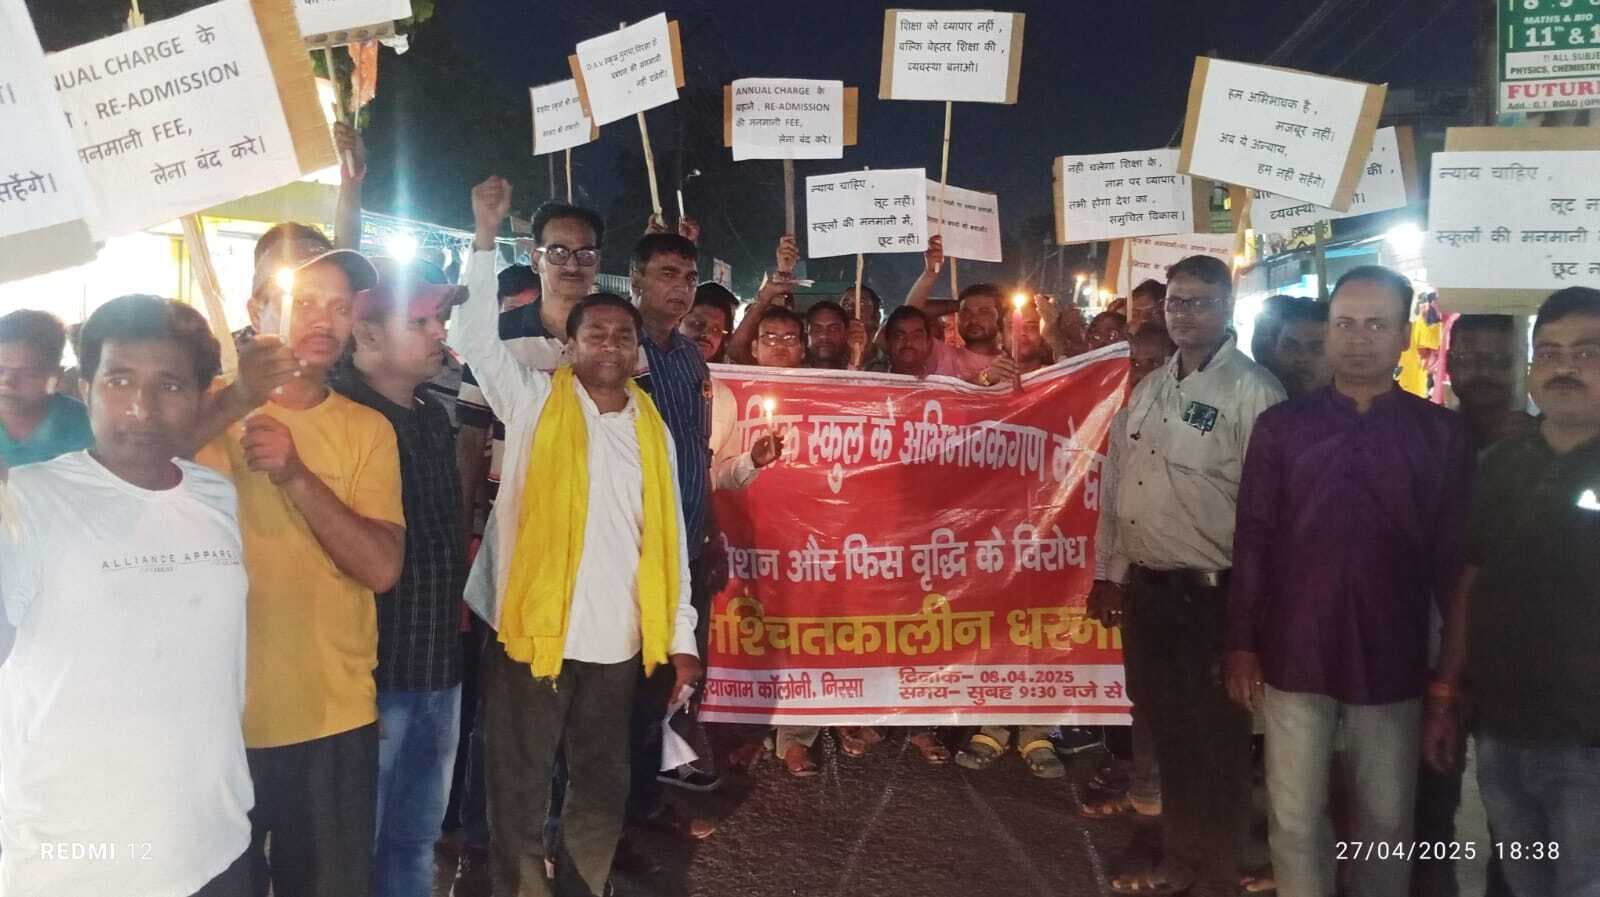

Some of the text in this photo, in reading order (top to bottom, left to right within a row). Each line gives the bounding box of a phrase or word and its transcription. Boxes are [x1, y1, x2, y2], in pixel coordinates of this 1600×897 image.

[900, 20, 922, 32] शिक्षा
[926, 20, 938, 31] को
[943, 22, 973, 32] व्यापार
[1523, 15, 1560, 24] MATHS
[1568, 28, 1584, 44] &
[104, 36, 184, 76] CHARGE
[196, 24, 216, 45] के
[957, 40, 979, 52] शिक्षा
[984, 40, 996, 52] की
[95, 61, 240, 120] RE-ADMISSION
[736, 87, 772, 96] ANNUAL
[774, 87, 810, 95] CHARGE
[1228, 88, 1244, 100] हम
[765, 103, 830, 111] RE-ADMISSION
[152, 118, 193, 142] FEE,
[1275, 121, 1308, 138] मजबूर
[1219, 133, 1236, 144] अब
[150, 160, 187, 185] लेना
[195, 148, 223, 170] बंद
[1257, 163, 1273, 176] हम
[1439, 167, 1482, 180] न्याय
[1491, 162, 1539, 182] चाहिए
[811, 183, 834, 192] न्याय
[1550, 198, 1576, 215] लूट
[843, 217, 854, 227] की
[1437, 226, 1588, 248] स्कूलों की मनमानी
[1551, 262, 1579, 280] छूट
[808, 415, 867, 493] स्कूल
[870, 396, 896, 461] के
[899, 400, 1048, 482] अभिभावकगण
[102, 554, 176, 569] ALLIANCE
[787, 534, 839, 582] और
[843, 533, 904, 580] फिस
[910, 528, 968, 591] वृद्धि
[974, 526, 1005, 573] के
[1012, 523, 1088, 572] विरोध
[980, 671, 1074, 683] 08.04.2025
[968, 684, 1014, 705] सुबह
[1019, 687, 1057, 698] 9:30
[1063, 681, 1098, 699] बजे
[1103, 682, 1122, 699] से
